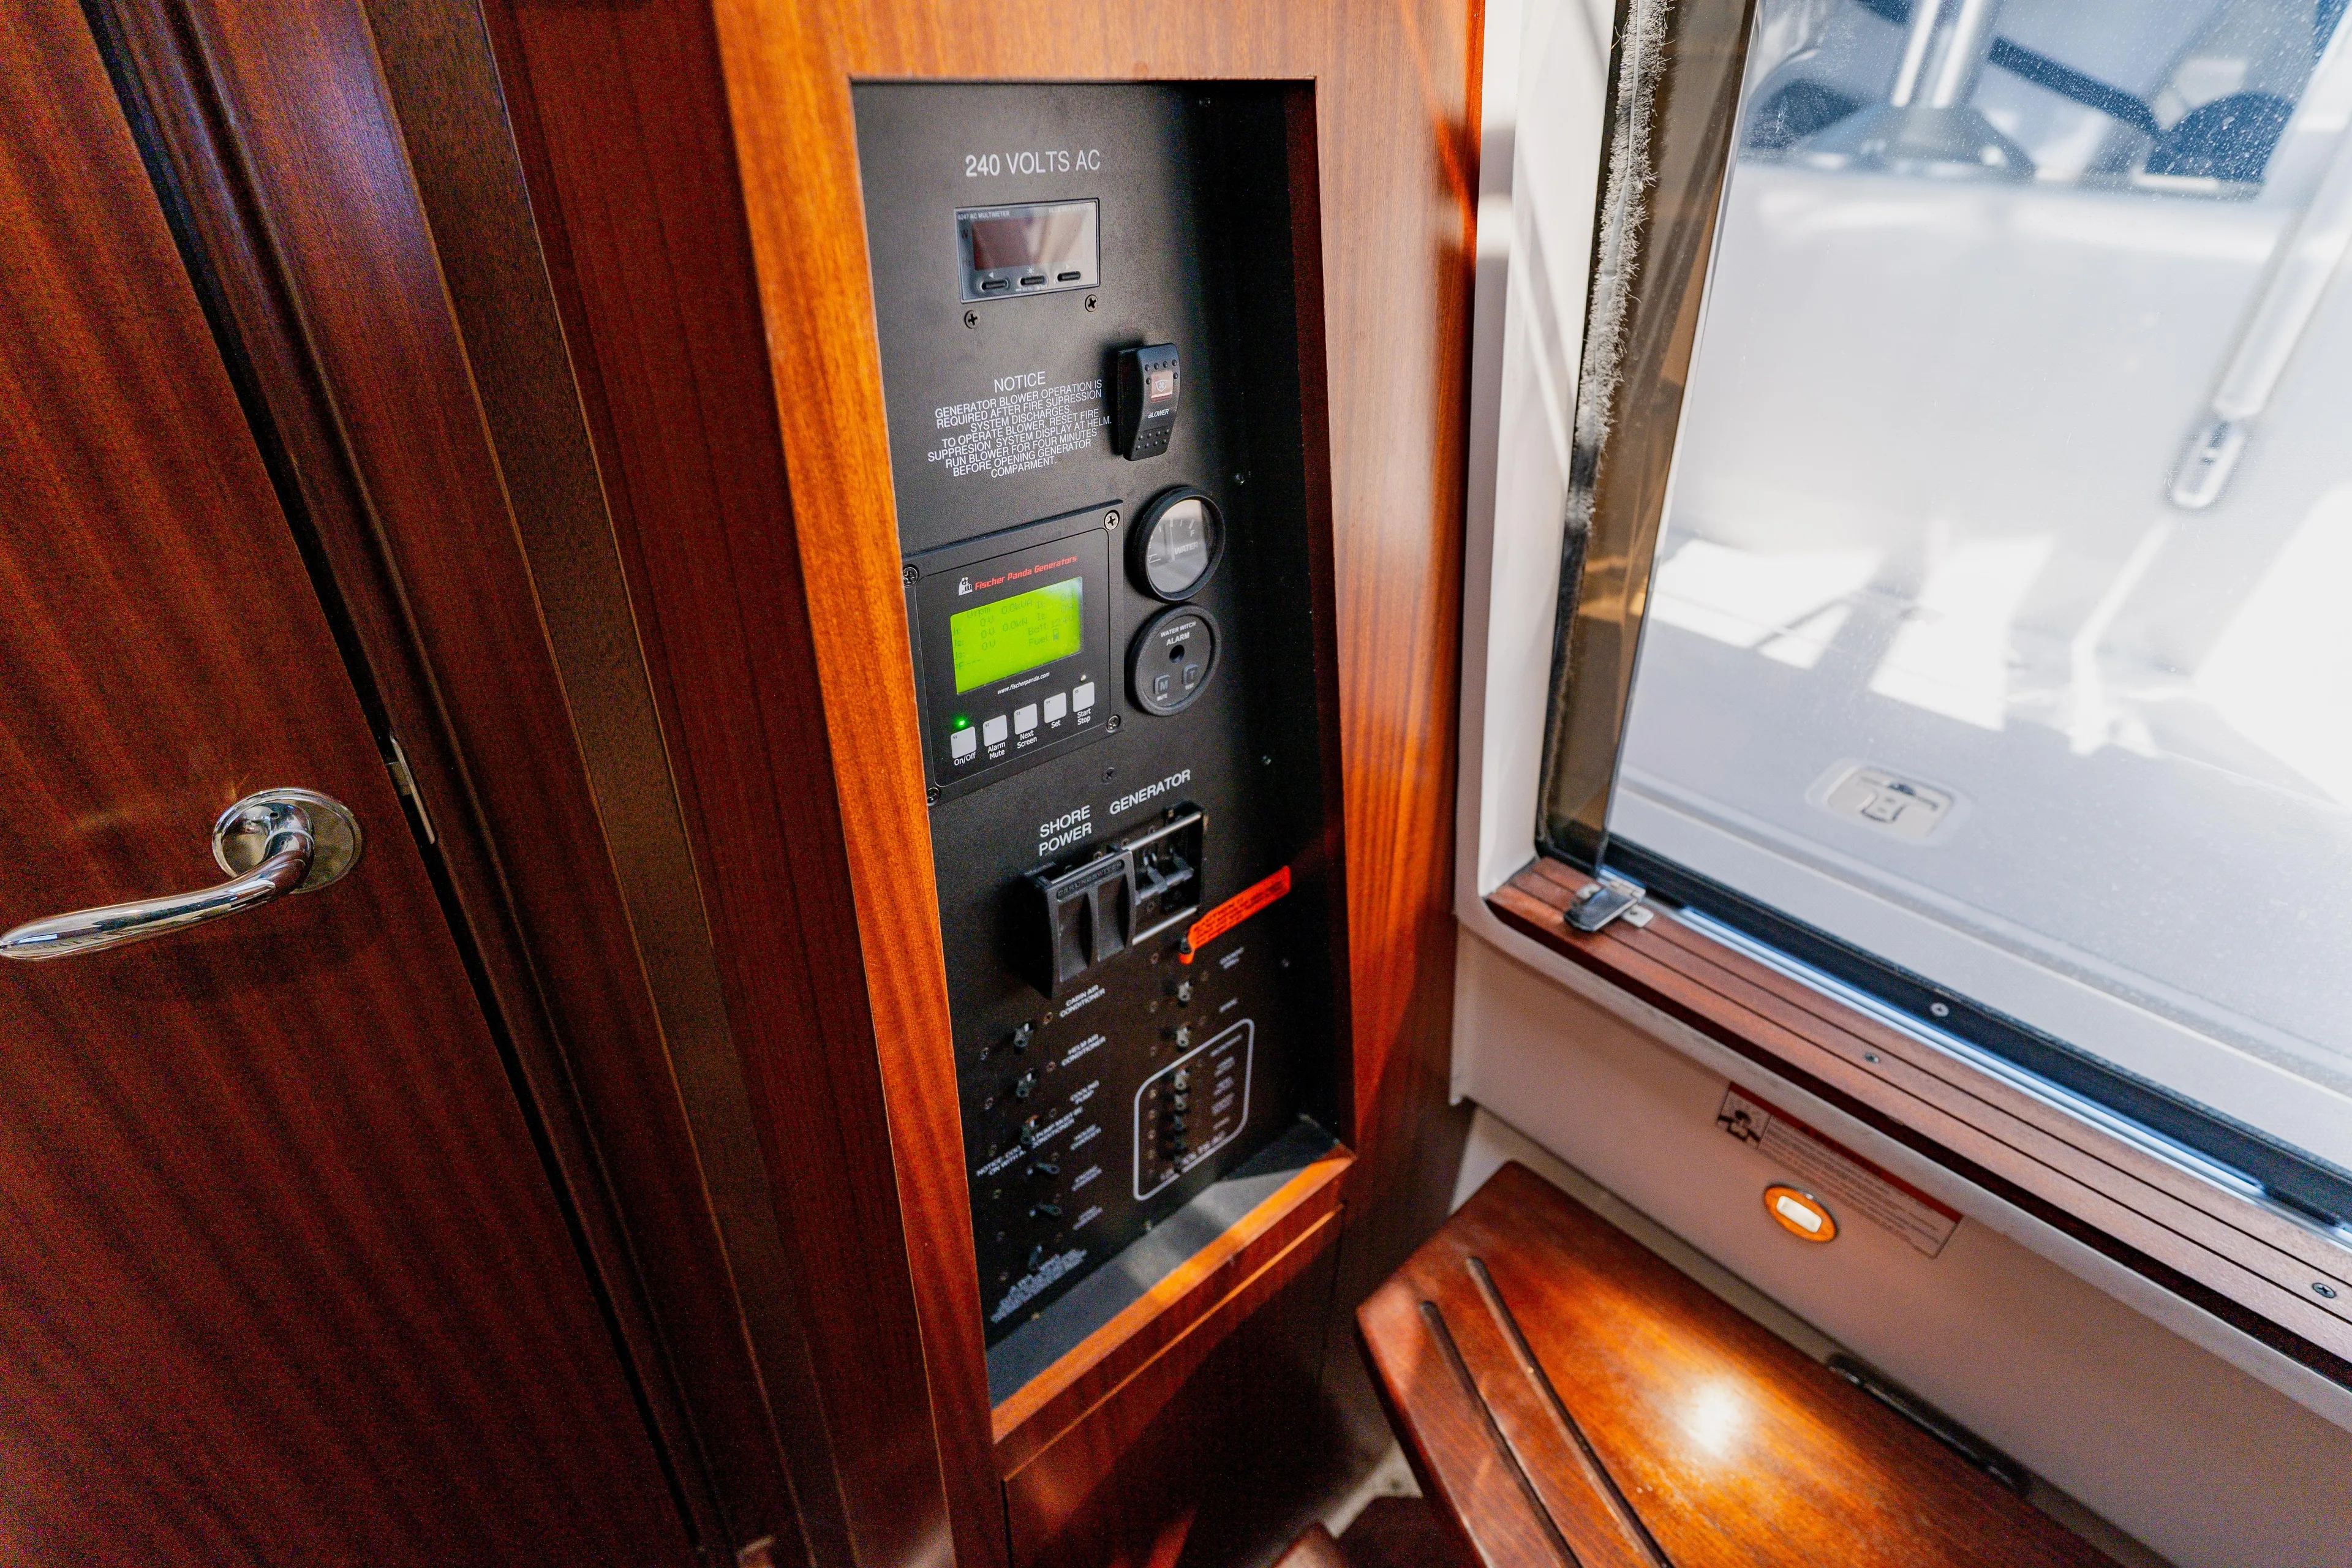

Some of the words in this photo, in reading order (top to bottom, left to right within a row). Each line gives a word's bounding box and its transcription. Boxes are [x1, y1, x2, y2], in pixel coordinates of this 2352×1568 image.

[965, 154, 1000, 177] 240
[1006, 150, 1070, 175] VOLTS
[1076, 149, 1101, 171] AC
[978, 210, 1010, 219] MULTIMETER
[994, 371, 1046, 393] NOTICE
[935, 398, 997, 419] GENERATOR
[999, 391, 1039, 407] BLOWER
[1041, 380, 1091, 399] OPERATION
[1095, 379, 1102, 389] IS
[937, 410, 988, 429] REQUIRED
[990, 404, 1020, 419] AFTER
[1023, 399, 1043, 412] FIRE
[1046, 389, 1101, 408] SUPRESSION
[971, 417, 1009, 432] SYSTEM
[1012, 405, 1072, 425] DISCHARGES.
[1148, 409, 1169, 418] BLOWER
[928, 440, 991, 462] SUPPRESION
[996, 431, 1033, 448] SYSTEM
[1036, 424, 1072, 440] DISPLAY
[1074, 420, 1085, 431] AT
[1087, 415, 1112, 428] HELM.
[941, 437, 956, 448] TO
[958, 428, 1003, 444] OPERATE
[1006, 420, 1047, 435] BLOWER,
[1050, 412, 1078, 427] RESET
[1080, 408, 1099, 421] FIRE
[946, 456, 967, 469] RUN
[969, 446, 1009, 464] BLOWER
[1012, 442, 1030, 454] FOR
[1033, 436, 1057, 450] FOUR
[1060, 428, 1097, 444] MINUTES
[953, 459, 992, 477] BEFORE
[994, 450, 1035, 467] OPENING
[1038, 438, 1091, 457] GENERATOR
[991, 455, 1057, 478] COMPARMENT.
[1174, 541, 1199, 555] WATER
[974, 576, 1005, 590] Fischer
[1007, 568, 1032, 581] Panda
[1034, 555, 1078, 574] Generators
[1160, 626, 1179, 638] WATER
[1180, 620, 1196, 631] WITCH
[1166, 631, 1190, 646] ALARM
[997, 672, 1050, 695] www.fischerpanda.com
[1160, 679, 1169, 691] M
[1156, 693, 1168, 702] MUTE
[1077, 708, 1091, 718] Start
[1077, 715, 1091, 726] Stop
[1019, 729, 1034, 741] Next
[1051, 720, 1061, 729] Set
[987, 741, 1006, 754] Alarm
[1017, 736, 1038, 749] Screen
[954, 752, 976, 766] On/Off
[989, 748, 1005, 760] Mute
[1109, 769, 1191, 815] GENERATOR
[1039, 805, 1091, 838] SHORE
[1039, 822, 1092, 856] POWER
[1059, 988, 1105, 1018] CONDITIONER
[1066, 991, 1087, 1007] CABIN
[1087, 984, 1099, 995] AIR
